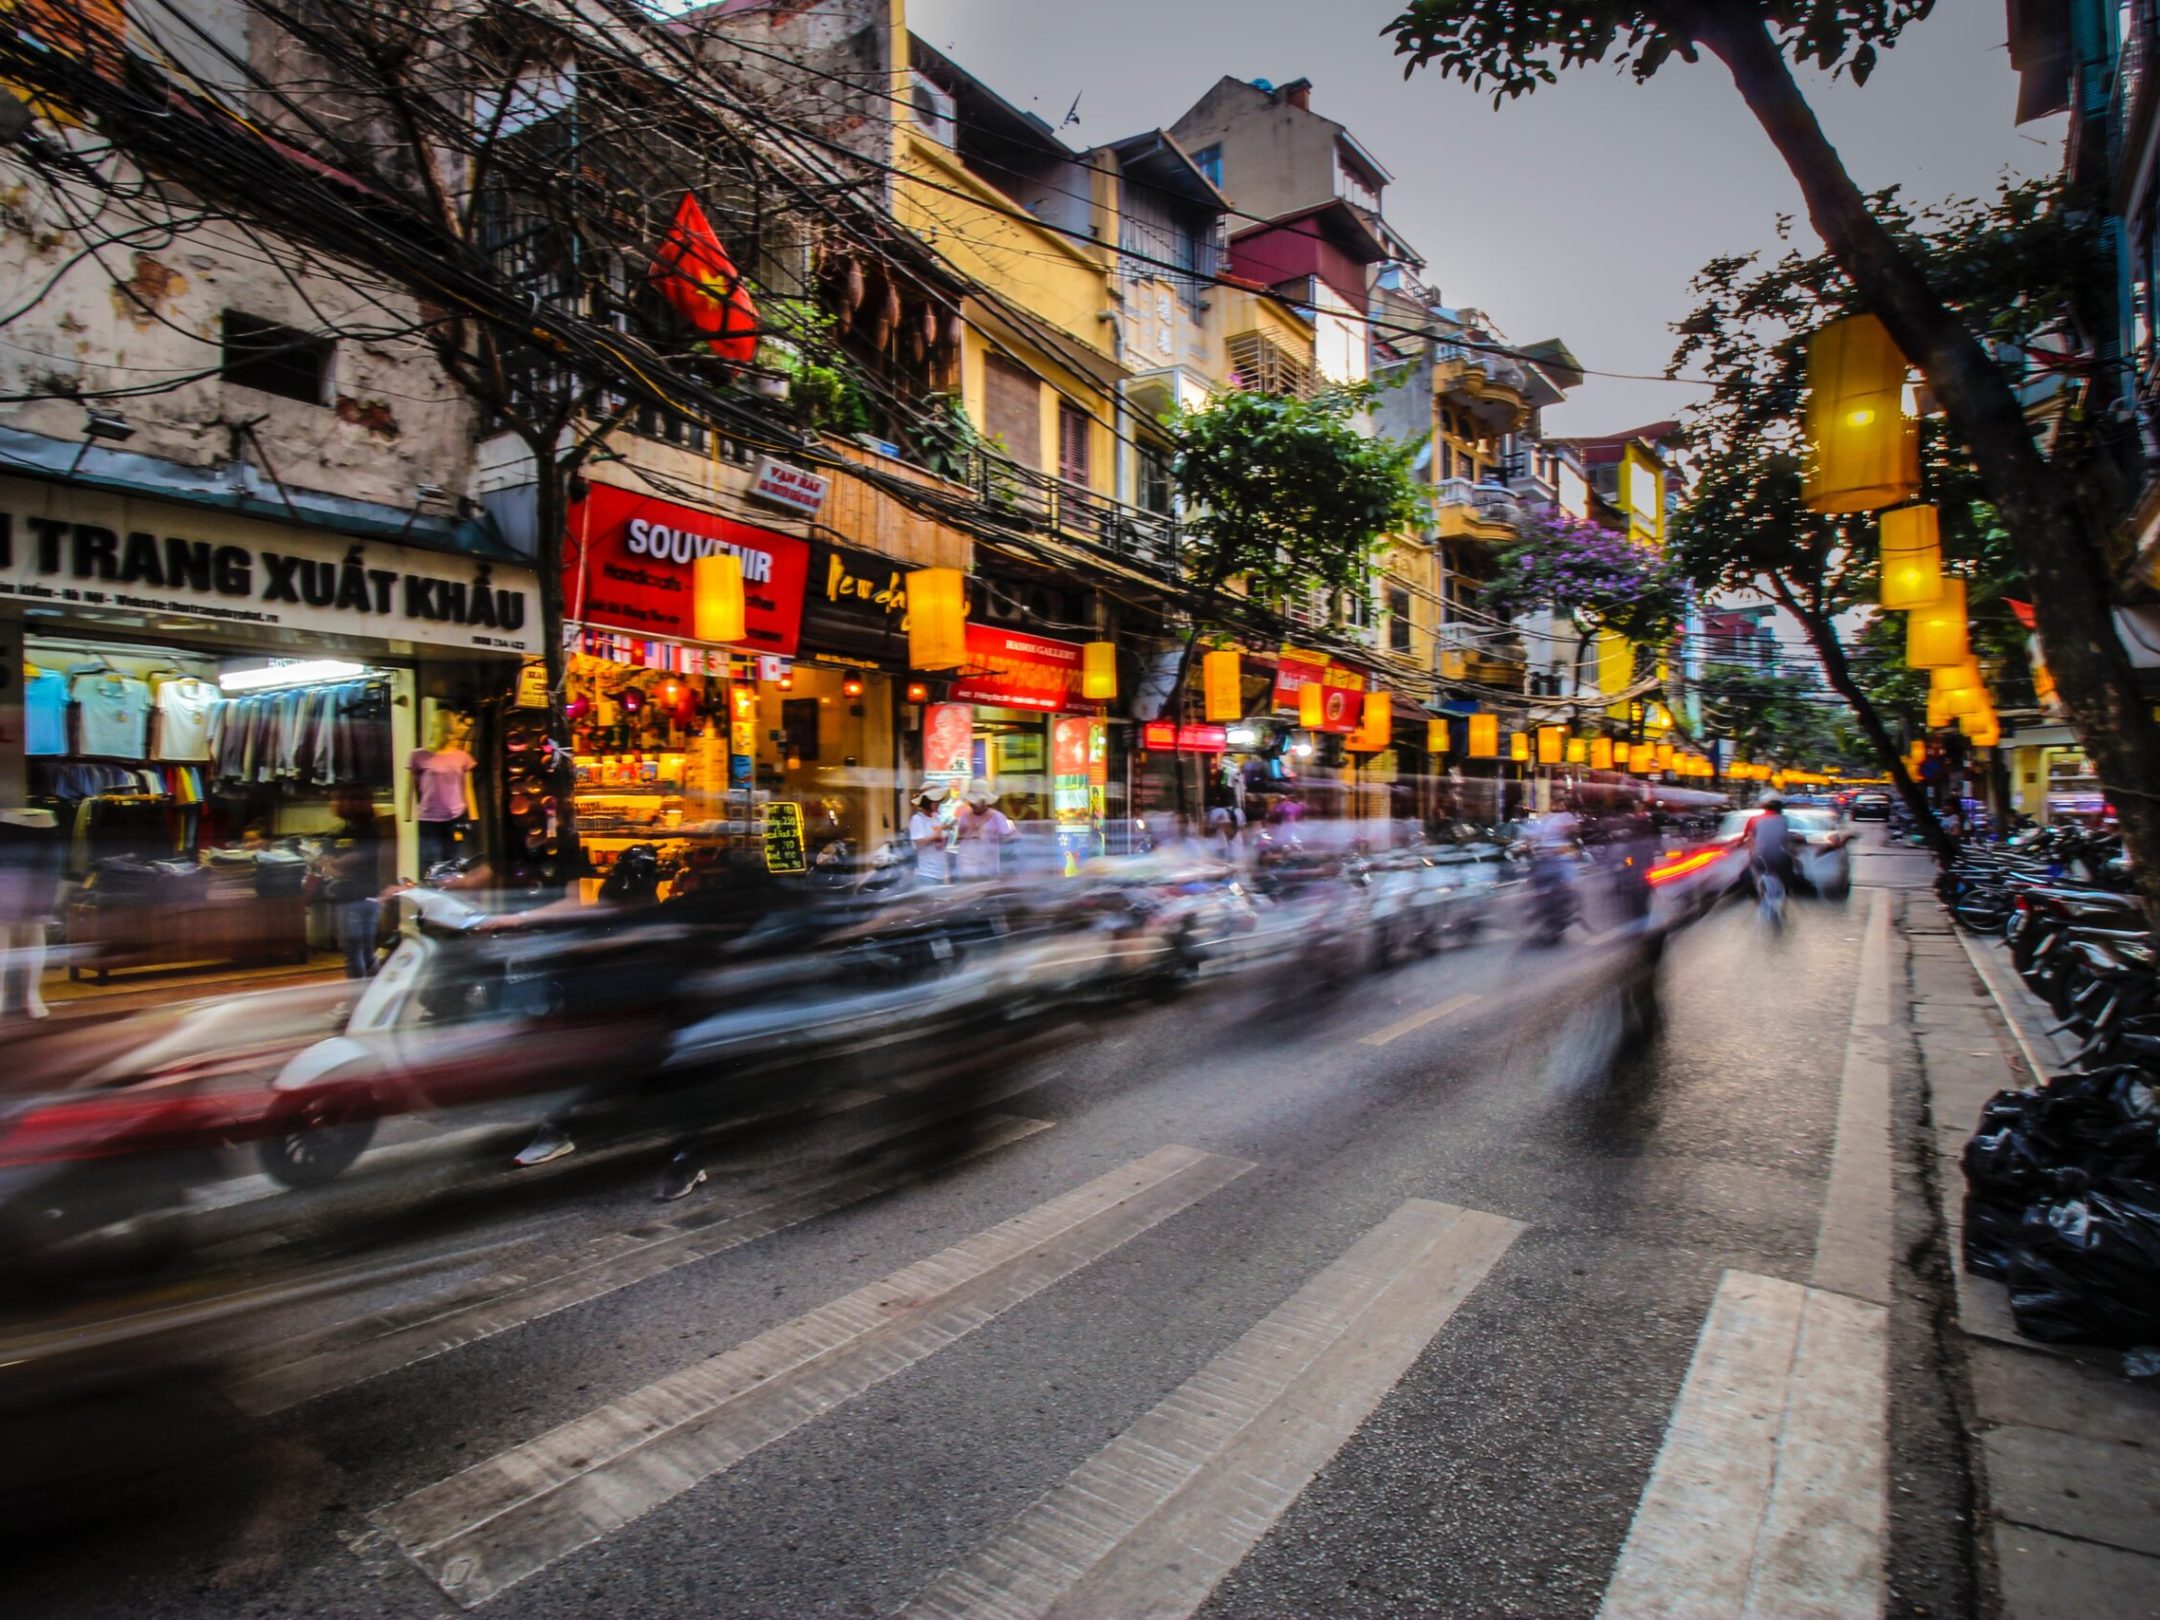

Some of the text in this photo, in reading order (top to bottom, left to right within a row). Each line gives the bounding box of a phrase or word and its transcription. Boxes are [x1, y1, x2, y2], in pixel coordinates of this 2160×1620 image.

[26, 517, 252, 596] TRANG
[261, 544, 398, 614] XUẤT
[404, 564, 524, 631] KHẨU
